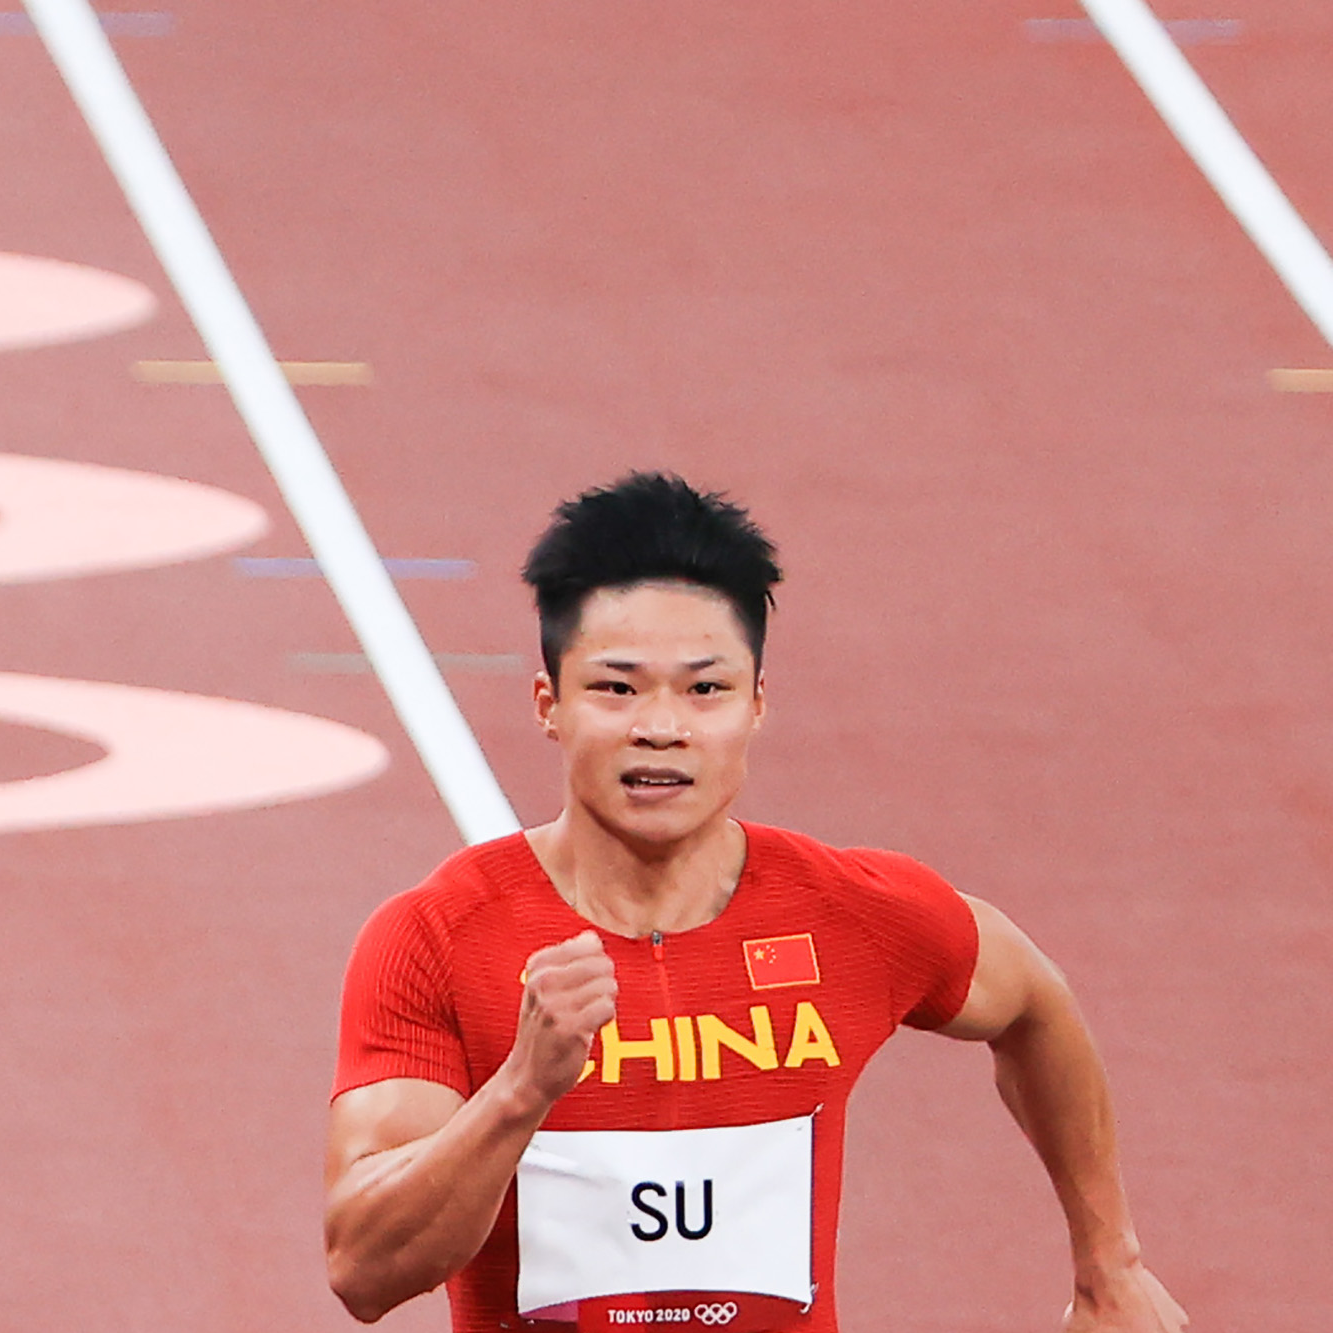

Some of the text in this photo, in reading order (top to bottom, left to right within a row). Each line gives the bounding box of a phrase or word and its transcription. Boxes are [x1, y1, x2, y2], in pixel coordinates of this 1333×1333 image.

[577, 1001, 841, 1084] HINA
[630, 1178, 714, 1242] SU
[607, 1307, 691, 1325] TOKYO 2020
